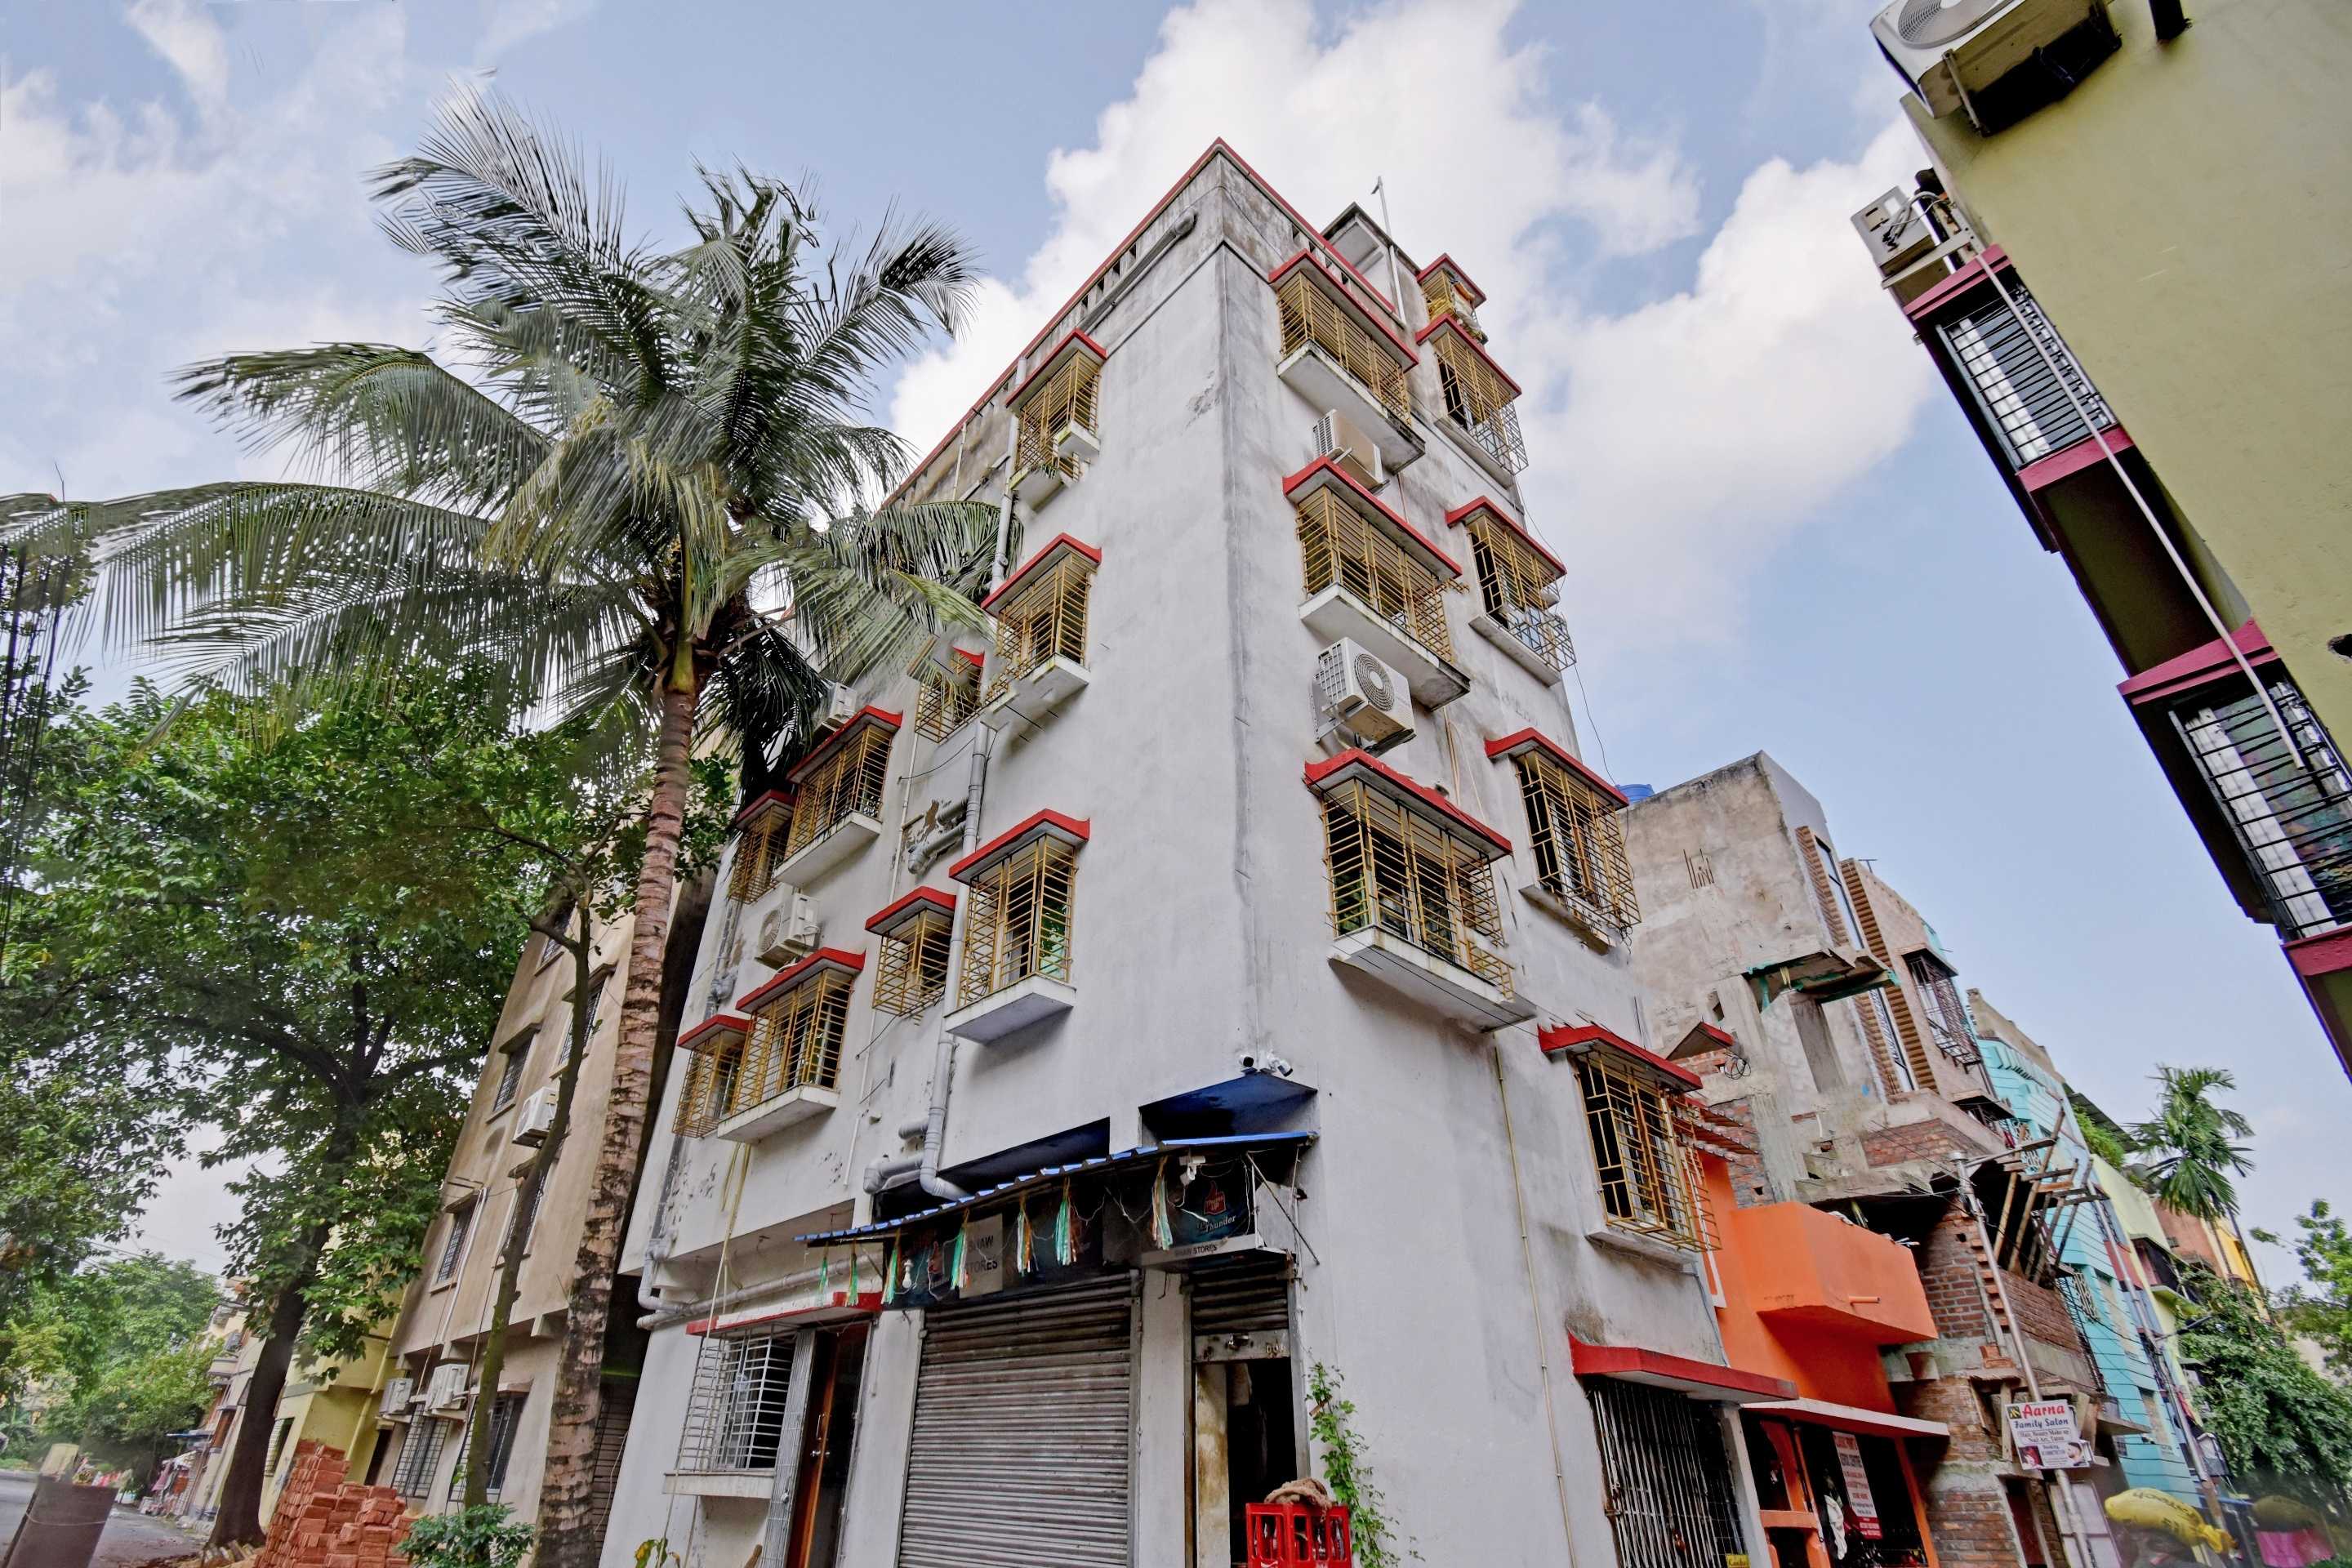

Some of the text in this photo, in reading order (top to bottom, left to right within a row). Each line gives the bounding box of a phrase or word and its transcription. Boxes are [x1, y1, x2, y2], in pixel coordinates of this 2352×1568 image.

[2022, 1404, 2065, 1419] Aarna
[2014, 1418, 2069, 1429] Family Salon
